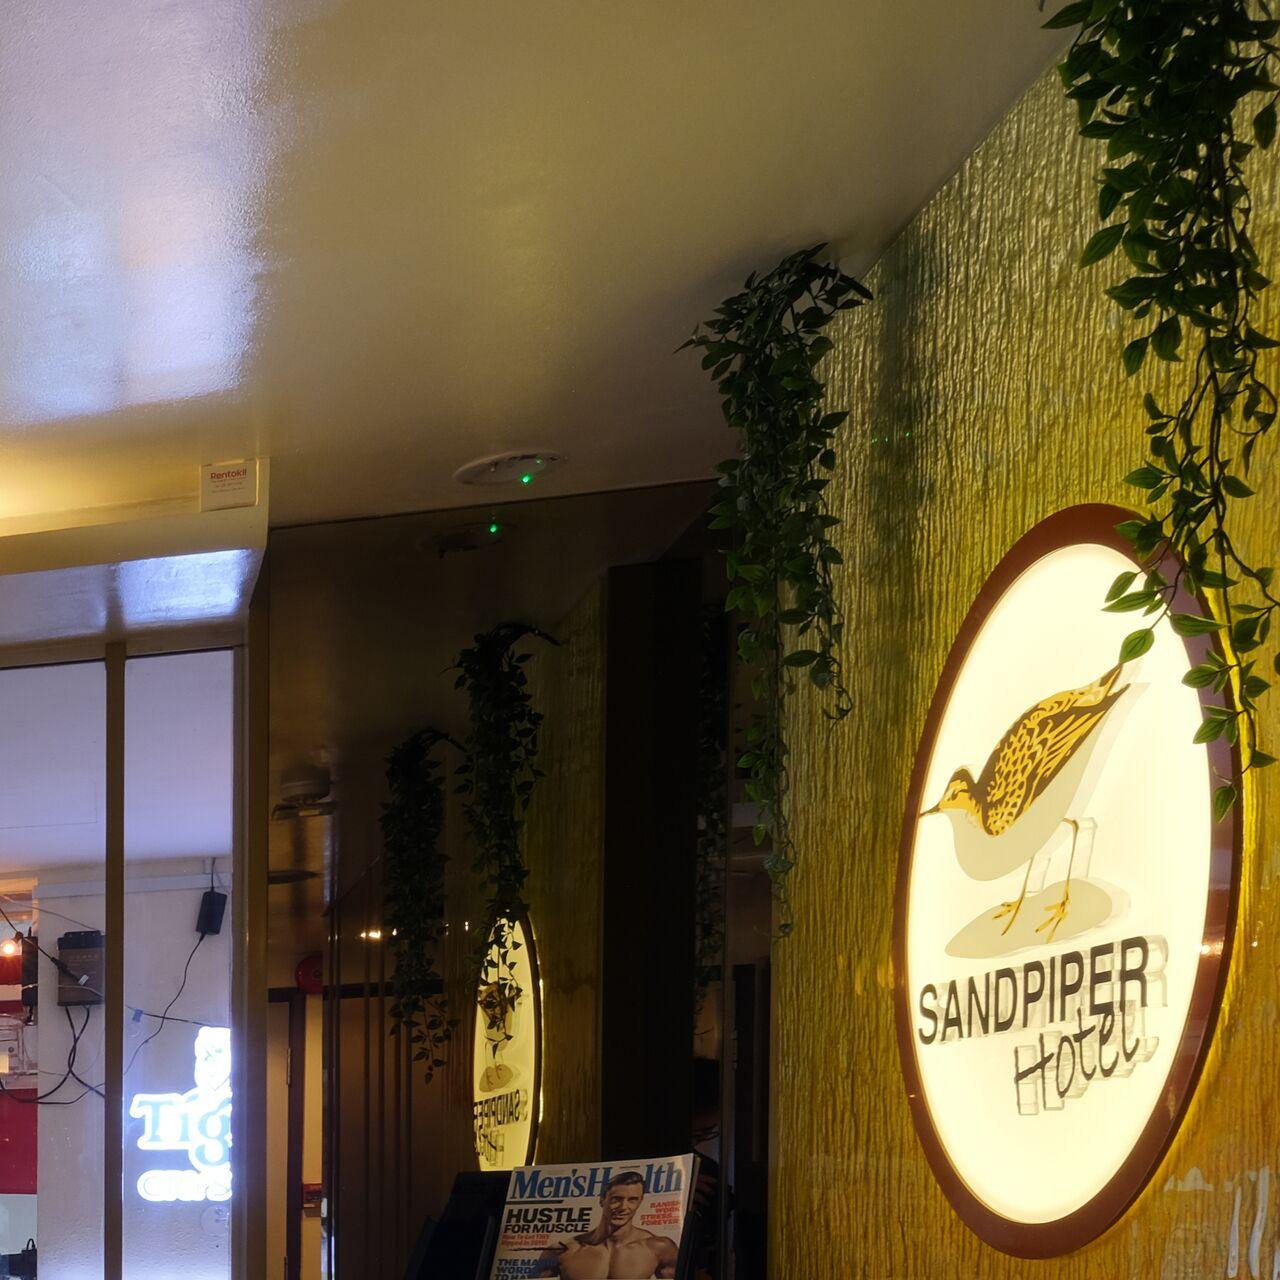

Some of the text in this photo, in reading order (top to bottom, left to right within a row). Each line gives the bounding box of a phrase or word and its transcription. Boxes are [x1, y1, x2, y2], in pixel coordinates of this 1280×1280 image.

[210, 468, 247, 480] Rentokil
[919, 936, 1150, 1047] SANDPIPER
[1013, 1008, 1141, 1099] Hotel
[506, 1207, 592, 1224] HUSTLE
[504, 1223, 590, 1234] FOR MUSCLE
